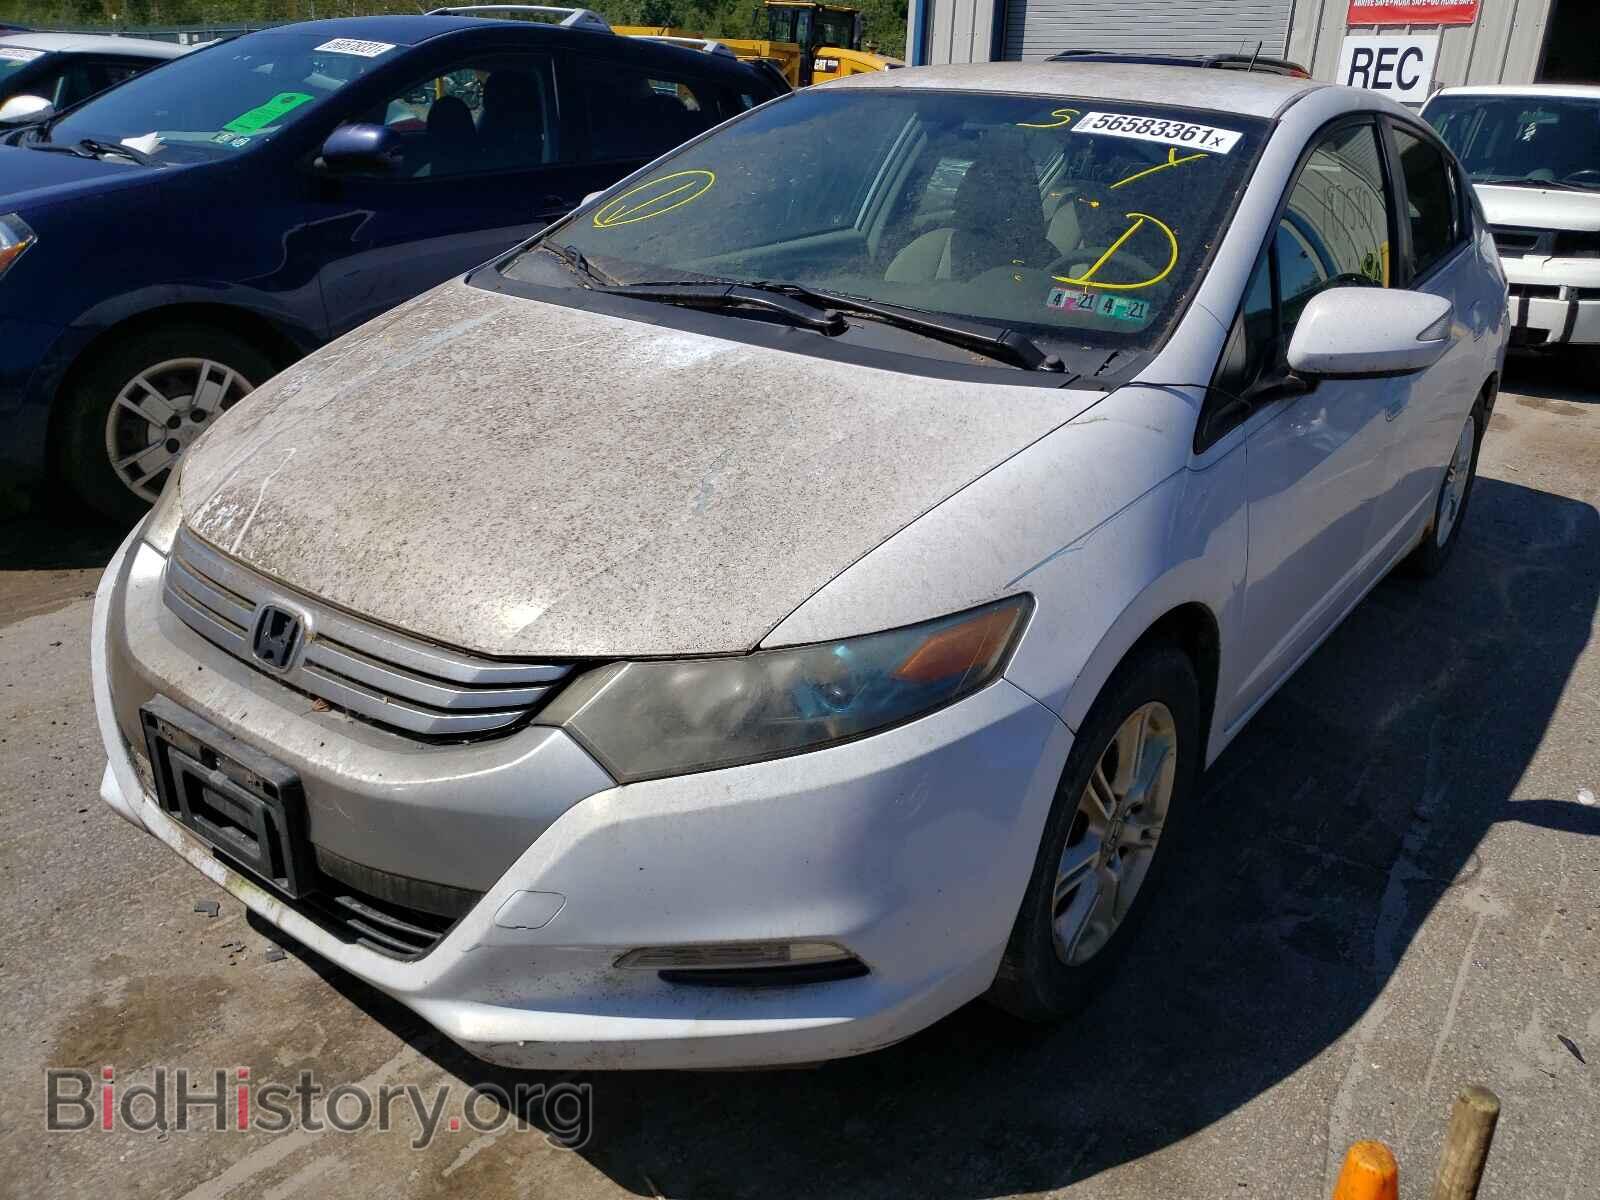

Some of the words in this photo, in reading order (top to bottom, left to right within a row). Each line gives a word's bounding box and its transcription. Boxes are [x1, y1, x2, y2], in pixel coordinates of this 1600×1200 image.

[814, 59, 827, 71] CAT
[1347, 46, 1424, 91] REC
[1053, 293, 1063, 306] 4
[1103, 297, 1114, 314] 4
[1129, 301, 1145, 318] 21
